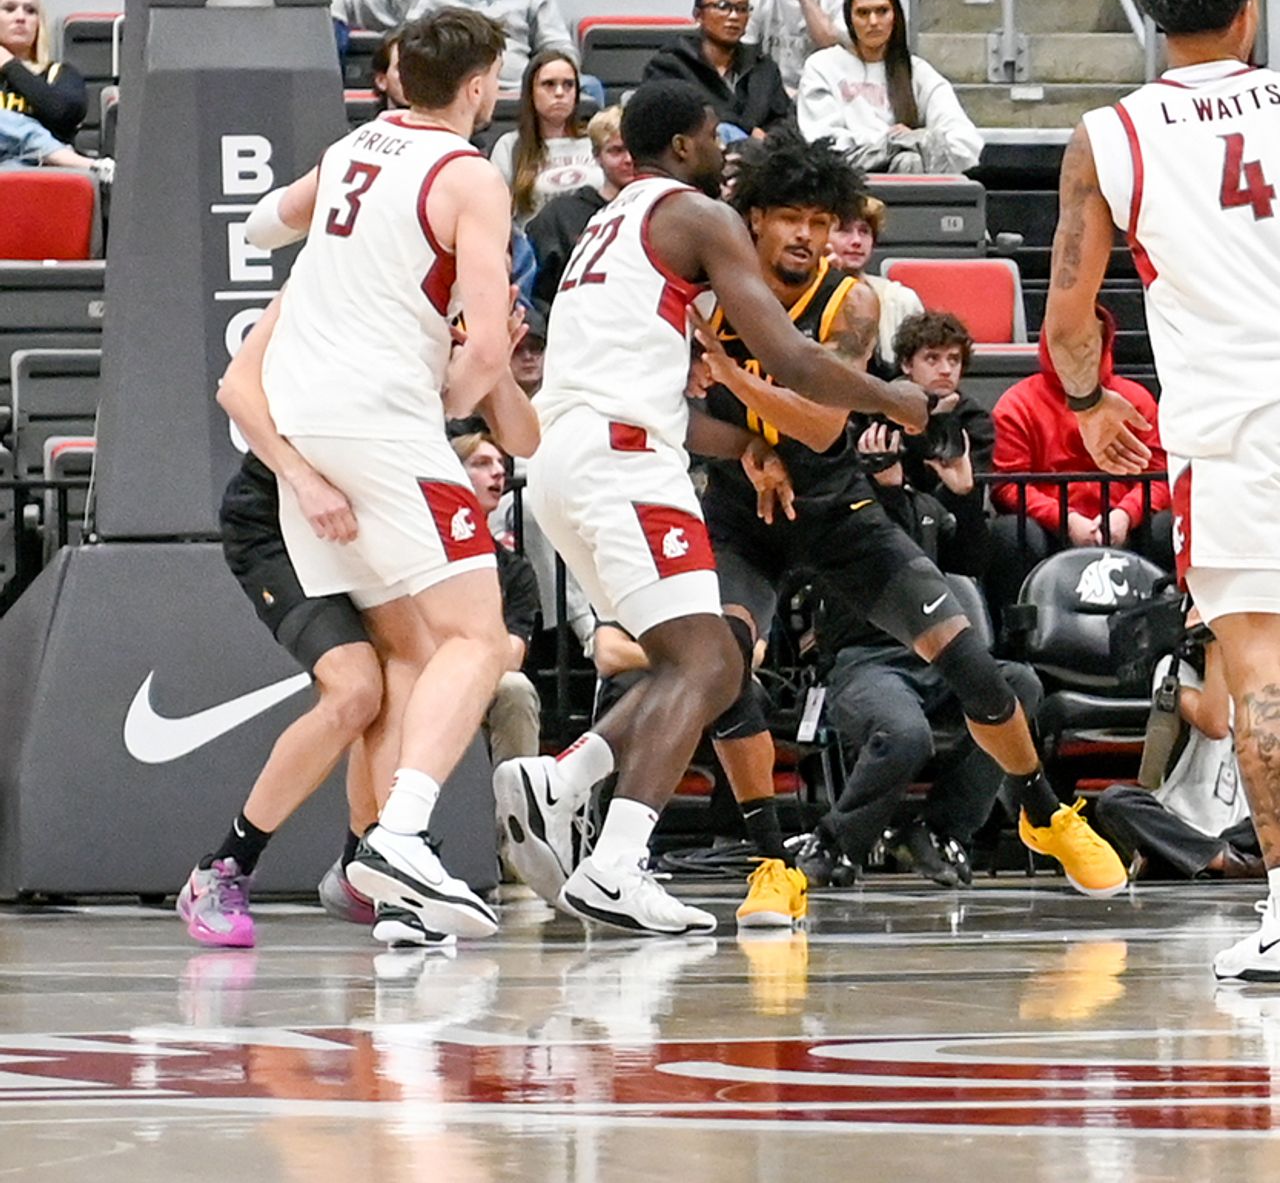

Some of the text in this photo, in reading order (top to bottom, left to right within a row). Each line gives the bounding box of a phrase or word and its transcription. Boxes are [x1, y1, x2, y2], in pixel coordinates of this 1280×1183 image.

[357, 130, 413, 157] PRICE
[1160, 101, 1188, 124] L.
[326, 159, 383, 237] 3
[1216, 132, 1277, 221] 4
[560, 214, 627, 293] 22
